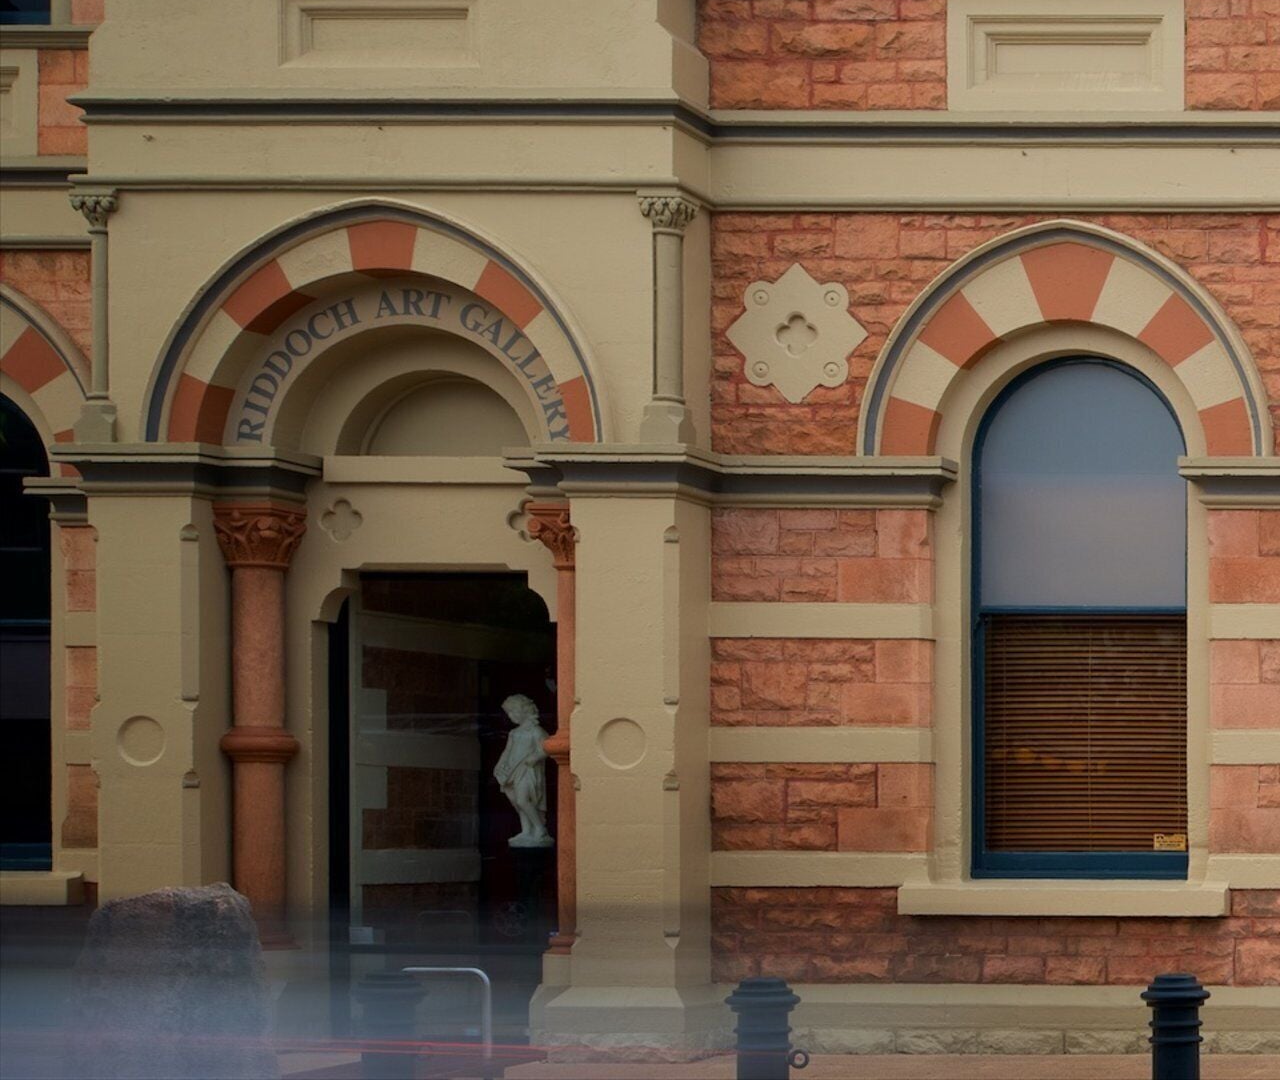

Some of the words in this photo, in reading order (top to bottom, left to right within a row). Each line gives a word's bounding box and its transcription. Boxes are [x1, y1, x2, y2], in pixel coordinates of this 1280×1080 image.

[236, 297, 362, 443] RIDDOCH
[375, 288, 451, 320] ART
[459, 303, 571, 443] GALLERY
